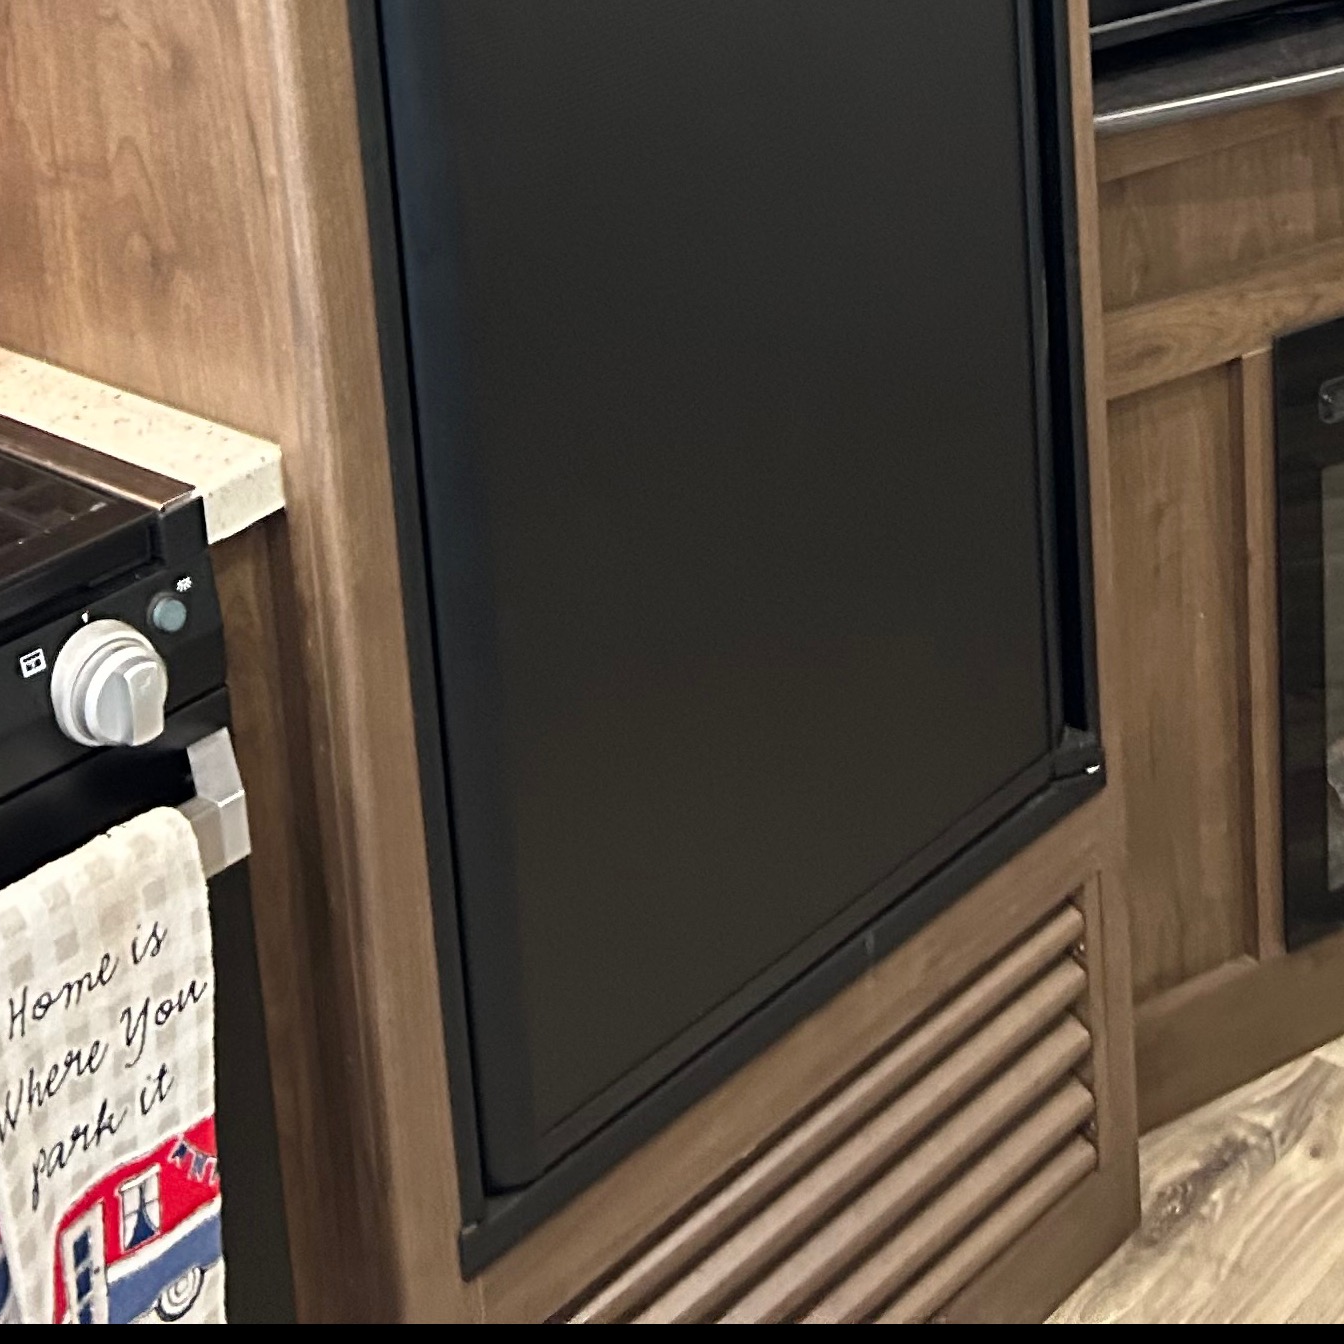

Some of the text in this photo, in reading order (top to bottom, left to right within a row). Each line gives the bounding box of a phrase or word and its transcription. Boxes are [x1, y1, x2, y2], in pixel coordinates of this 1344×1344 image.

[8, 921, 169, 1041] Home is
[119, 979, 208, 1069] You
[31, 1062, 175, 1212] park it
